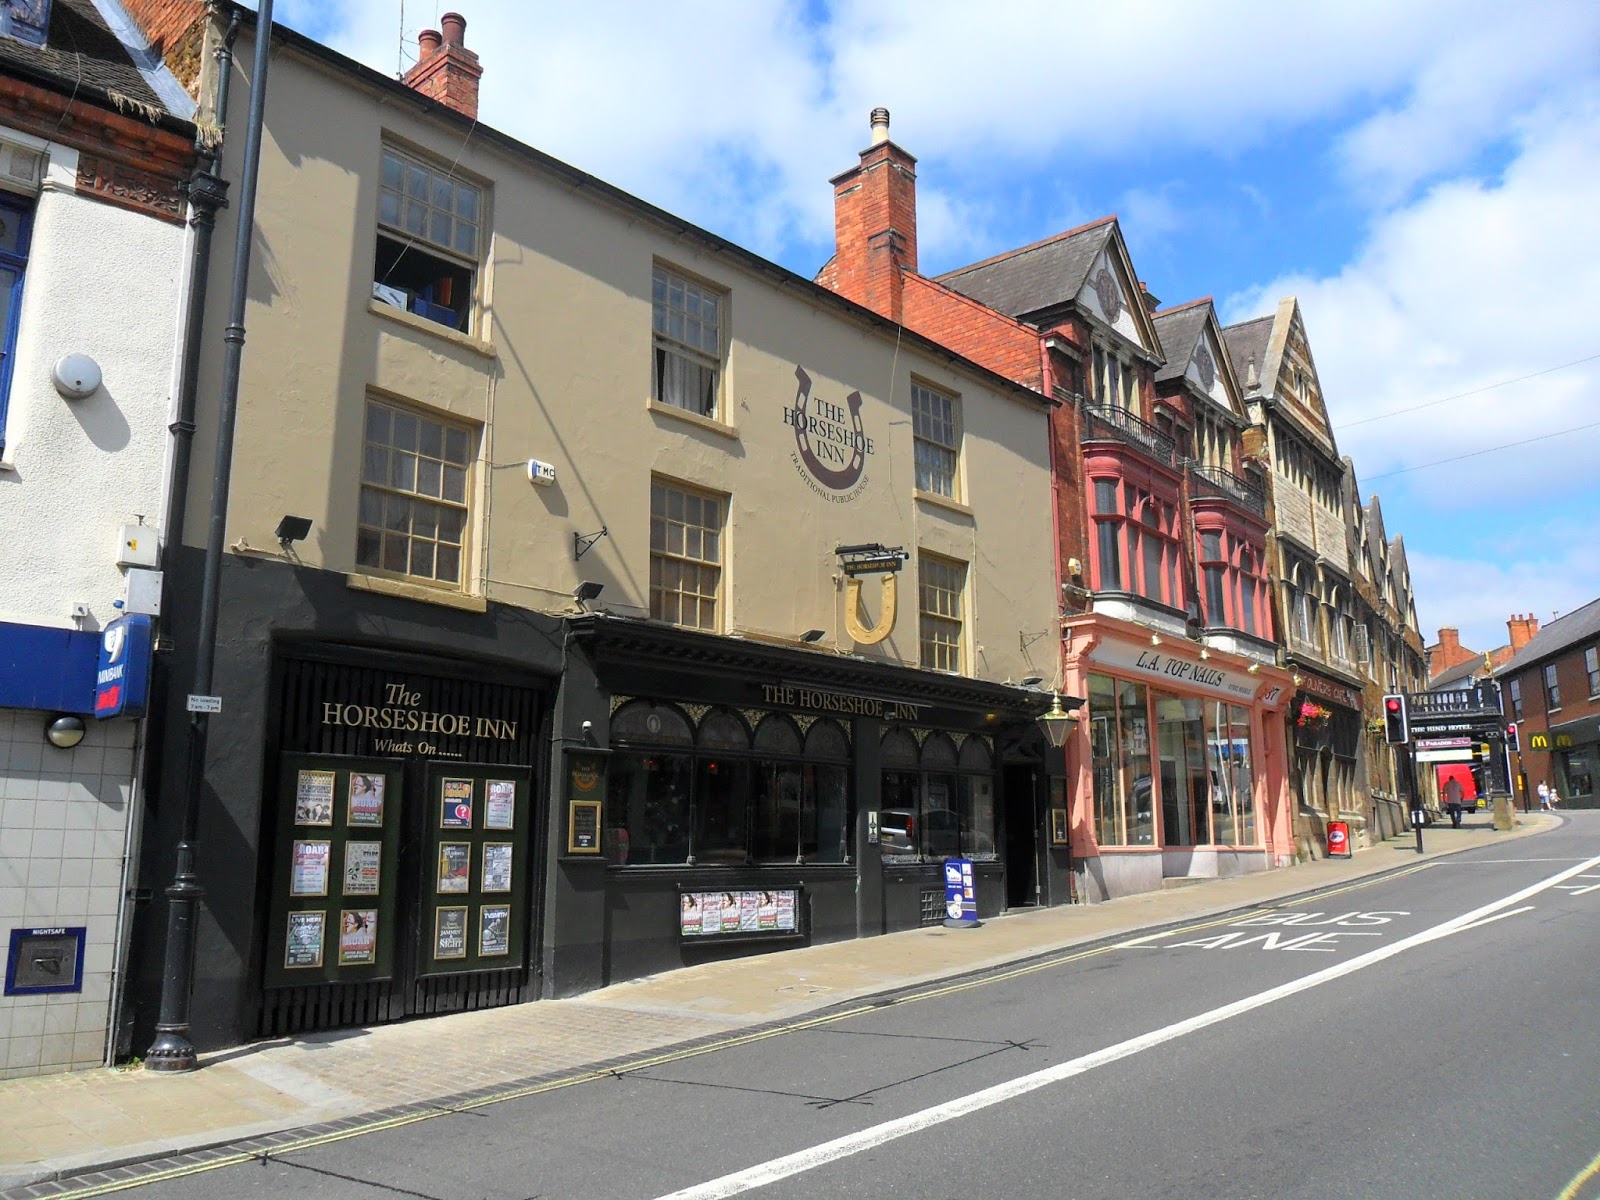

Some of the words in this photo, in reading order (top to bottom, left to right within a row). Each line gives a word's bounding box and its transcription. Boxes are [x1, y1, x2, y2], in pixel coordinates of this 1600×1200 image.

[814, 398, 845, 425] THE
[783, 406, 874, 455] HORSESHOE
[816, 440, 845, 465] INN
[790, 451, 831, 502] TRADITIONAL
[831, 492, 854, 504] PUBLIC
[853, 474, 870, 498] HOUSE
[1136, 651, 1160, 671] L.A.
[1164, 658, 1191, 678] TOP
[1188, 665, 1226, 687] NAILS
[385, 683, 421, 707] The
[762, 684, 795, 706] THE
[799, 689, 883, 717] HORSESHOE
[895, 703, 918, 721] INN
[322, 702, 470, 736] HORSESHOE
[475, 718, 517, 741] INN
[375, 738, 413, 753] Whats
[1228, 911, 1411, 926] BUS
